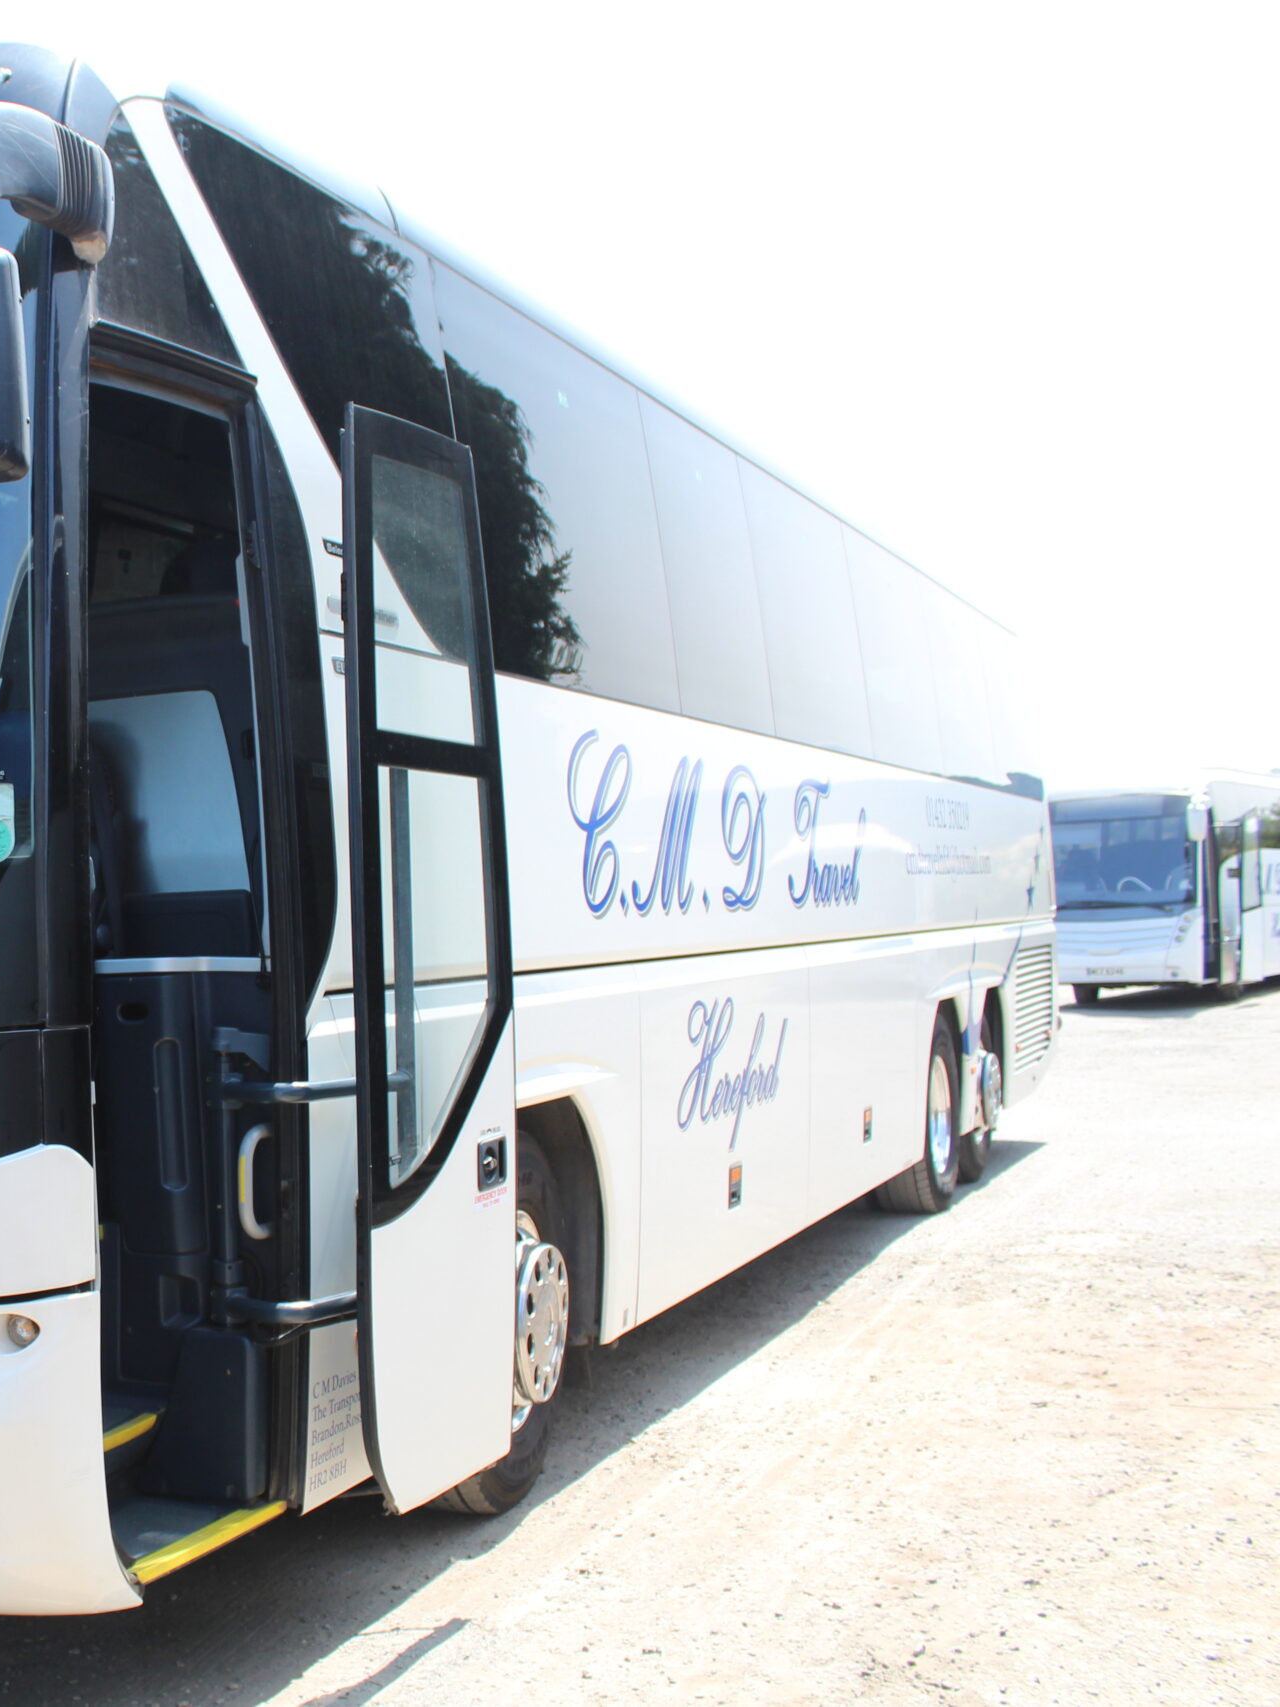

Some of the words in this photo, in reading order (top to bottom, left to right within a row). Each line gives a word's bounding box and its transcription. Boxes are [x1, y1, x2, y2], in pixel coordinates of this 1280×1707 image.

[787, 779, 866, 910] Travel
[677, 996, 788, 1153] Hereford
[332, 1370, 357, 1391] Davies
[313, 1405, 327, 1422] The
[310, 1437, 345, 1471] Hereford
[309, 1470, 328, 1492] HR2
